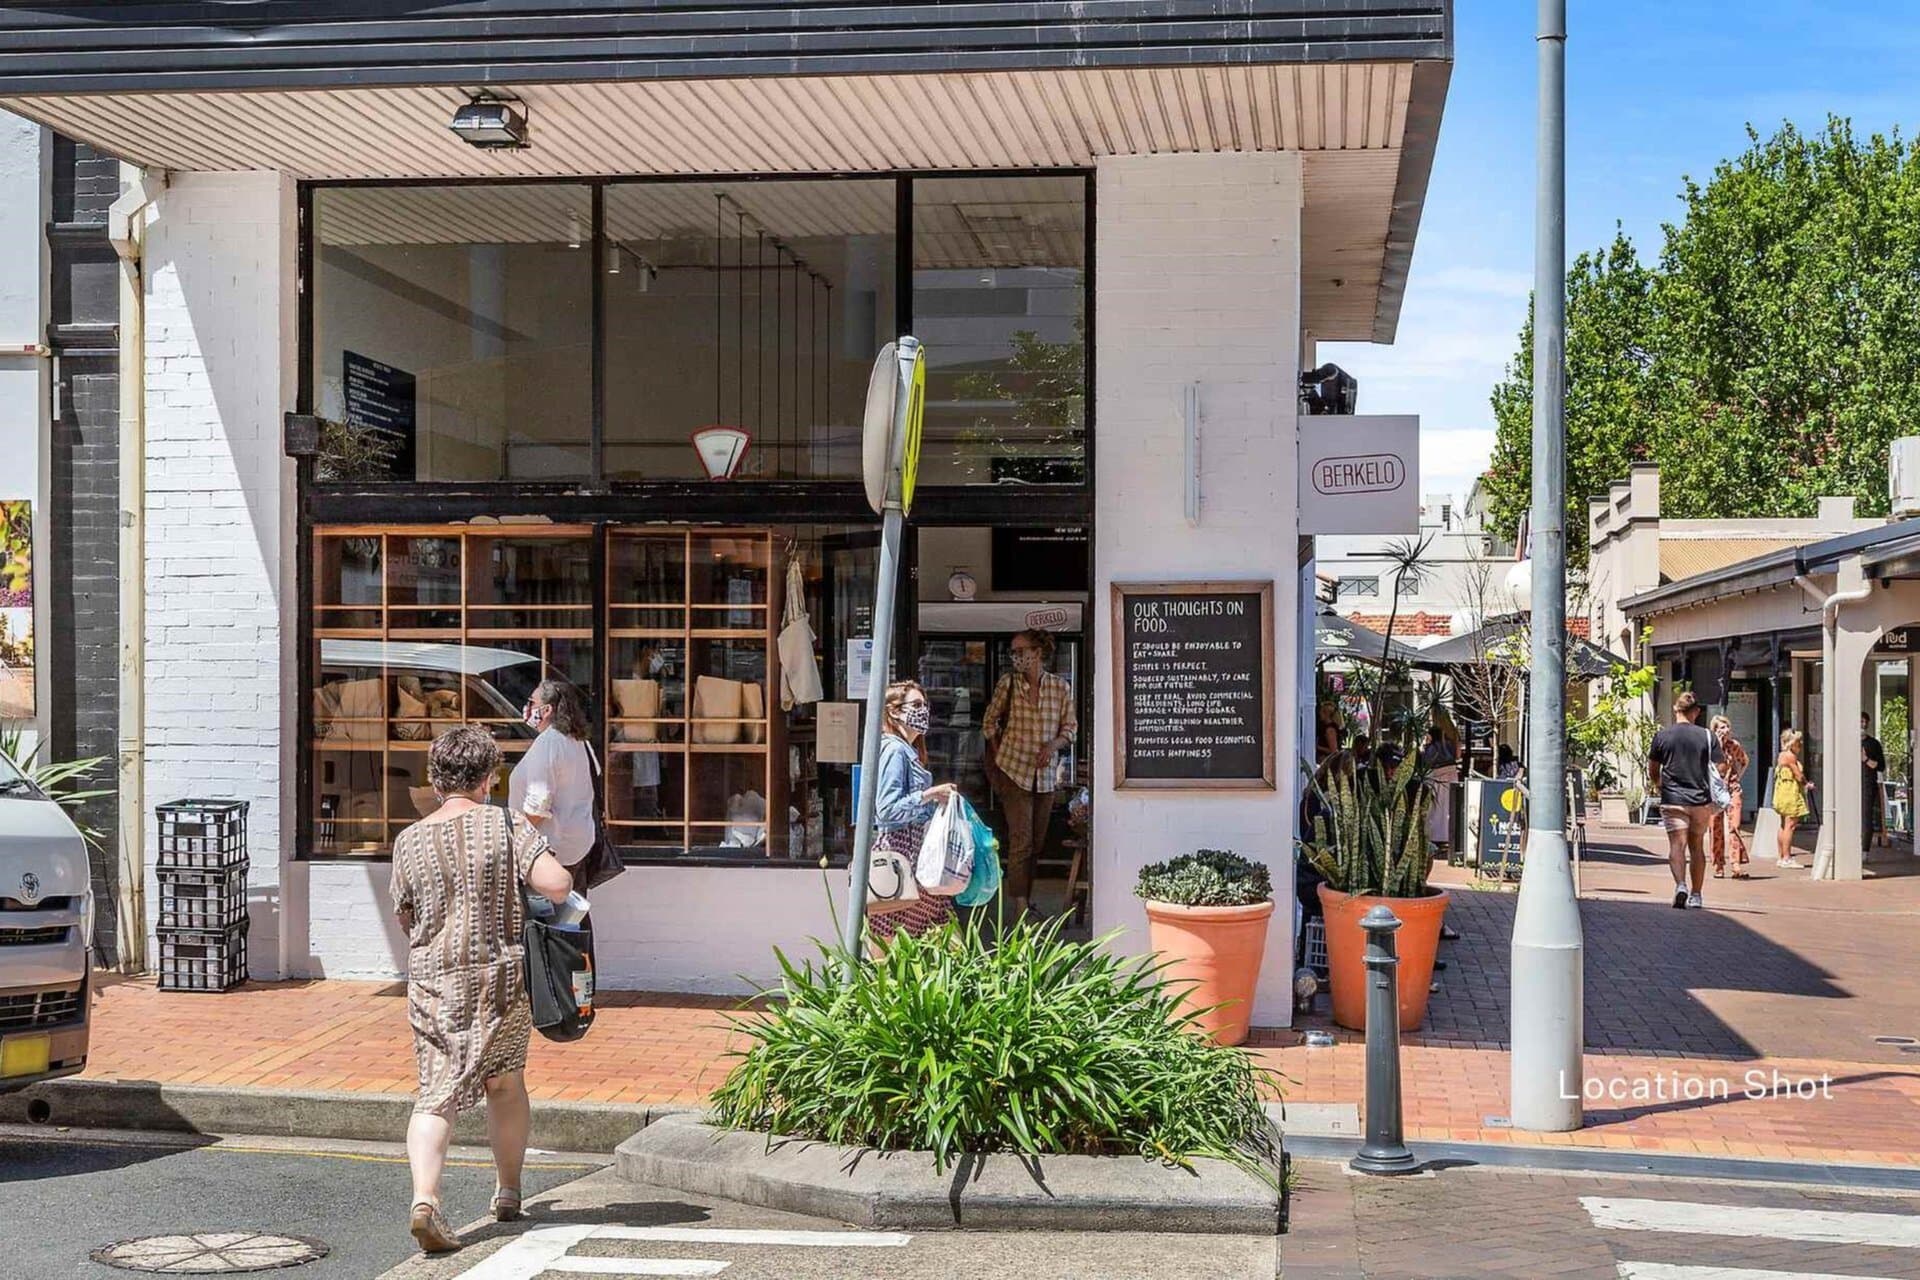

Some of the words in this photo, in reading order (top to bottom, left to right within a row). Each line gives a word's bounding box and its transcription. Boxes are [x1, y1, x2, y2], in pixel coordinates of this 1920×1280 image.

[1322, 460, 1395, 488] BERKELO
[1134, 602, 1159, 617] OUR
[1163, 601, 1223, 616] THOUGHTS
[1226, 601, 1244, 615] ON
[1134, 618, 1175, 633] FOOD...
[1133, 642, 1141, 650] IT
[1142, 642, 1170, 650] SHOULD
[1171, 642, 1181, 650] BE
[1184, 642, 1230, 651] ENJOYABLE
[1232, 642, 1242, 650] TO
[1133, 650, 1147, 658] EAT
[1133, 663, 1159, 671] SIMPLE
[1162, 662, 1171, 670] IS
[1167, 673, 1220, 683] SUSTAINABLY,
[1233, 673, 1251, 681] CARE
[1134, 682, 1147, 690] FOR
[1148, 682, 1163, 690] OUR
[1186, 692, 1207, 700] AVOID
[1209, 691, 1253, 700] COMMERCIAL
[1203, 717, 1244, 725] HEALTHIER
[1134, 736, 1168, 745] PROMOTES
[1171, 736, 1193, 744] LOCAL
[1195, 736, 1213, 744] FOOD
[1134, 749, 1165, 759] CREATES
[1168, 748, 1212, 758] HAPPINESS
